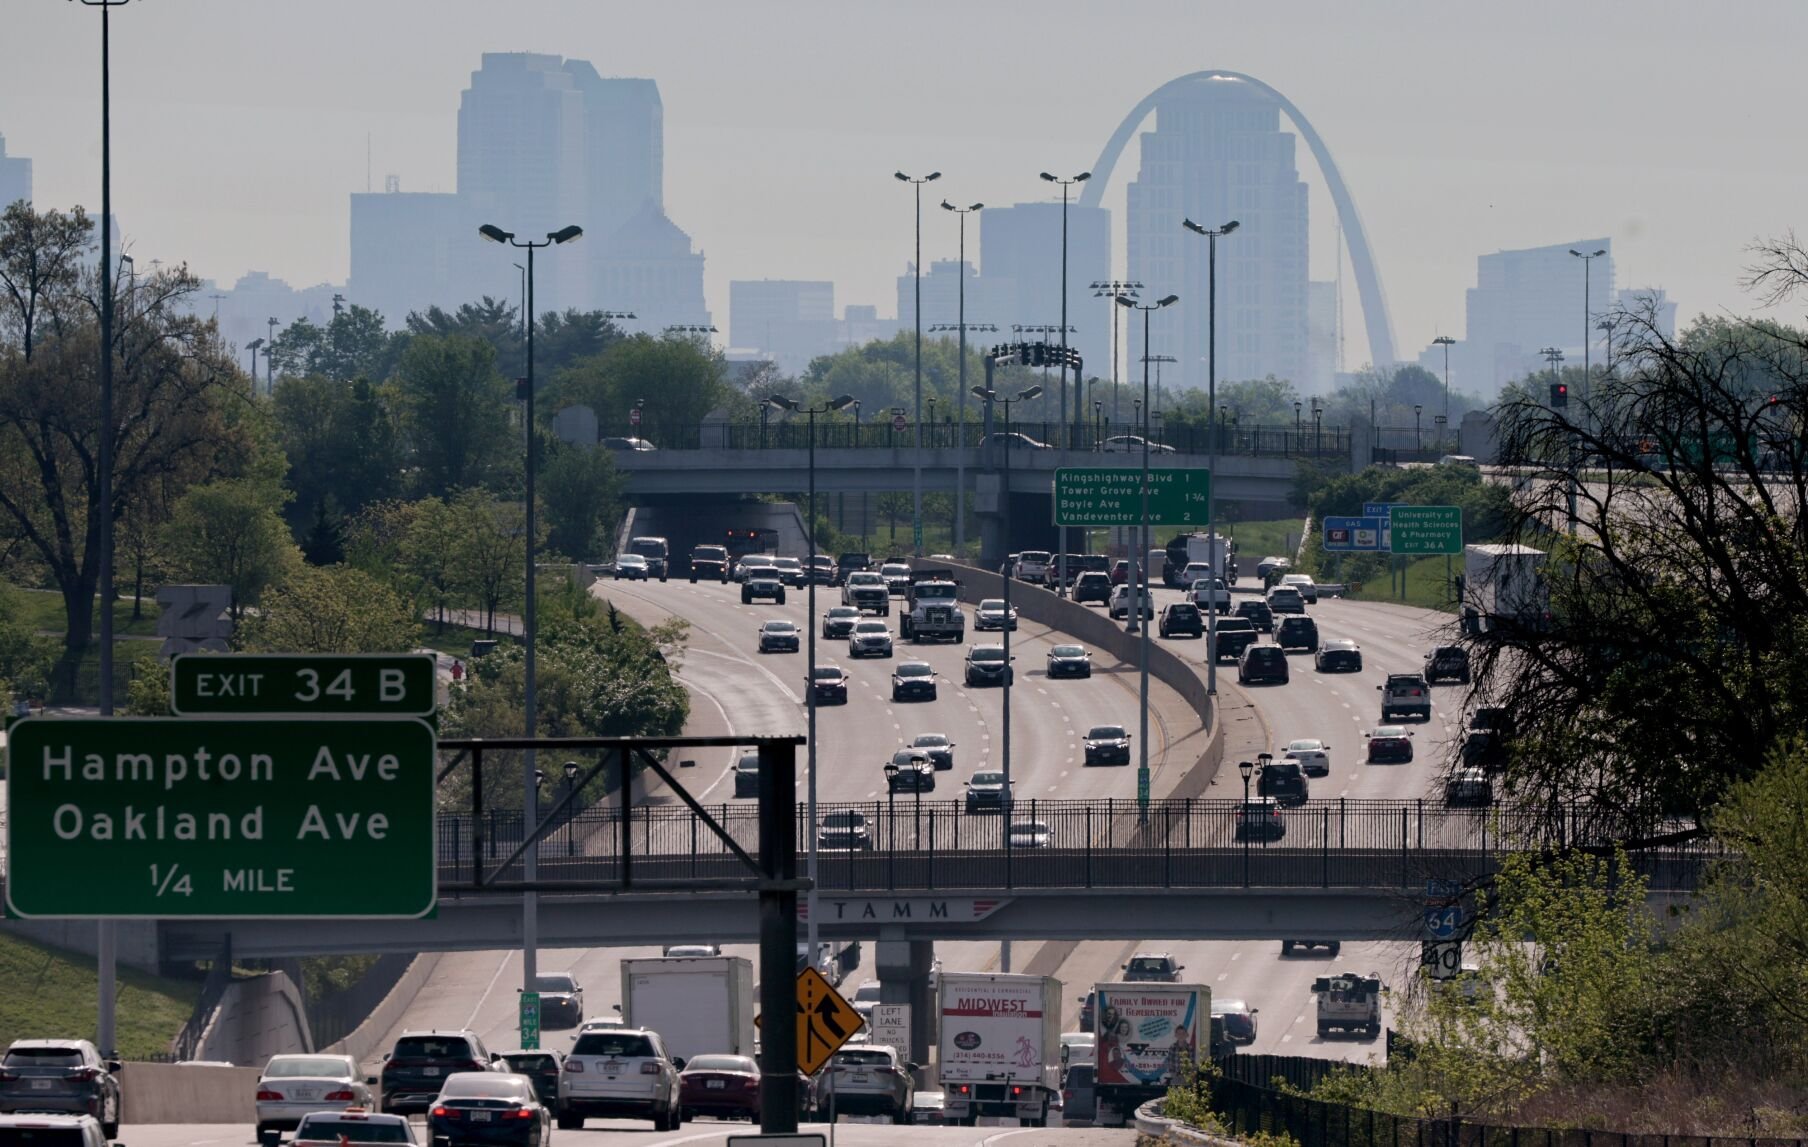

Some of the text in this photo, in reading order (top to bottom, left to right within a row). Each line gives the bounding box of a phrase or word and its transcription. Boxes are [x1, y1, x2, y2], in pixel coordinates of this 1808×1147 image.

[1061, 473, 1141, 484] Kingshighway
[1148, 473, 1173, 482] Blvd
[1062, 486, 1094, 495] Tower
[1100, 486, 1132, 495] Grove
[1061, 500, 1121, 510] Boyle Ave
[1062, 512, 1134, 521] Vandeventer
[1184, 512, 1190, 521] 2
[197, 669, 406, 701] EXIT 34 B
[42, 745, 400, 790] Hampton Ave
[53, 803, 389, 840] Oakland Ave
[223, 869, 294, 891] MILE
[833, 902, 948, 919] TAMM
[1428, 912, 1454, 930] 64
[1426, 948, 1457, 970] 40
[958, 998, 1027, 1011] MIDWEST
[992, 1010, 1027, 1018] Insulation
[1126, 1008, 1178, 1017] GENERATIONS
[522, 1028, 537, 1040] 34
